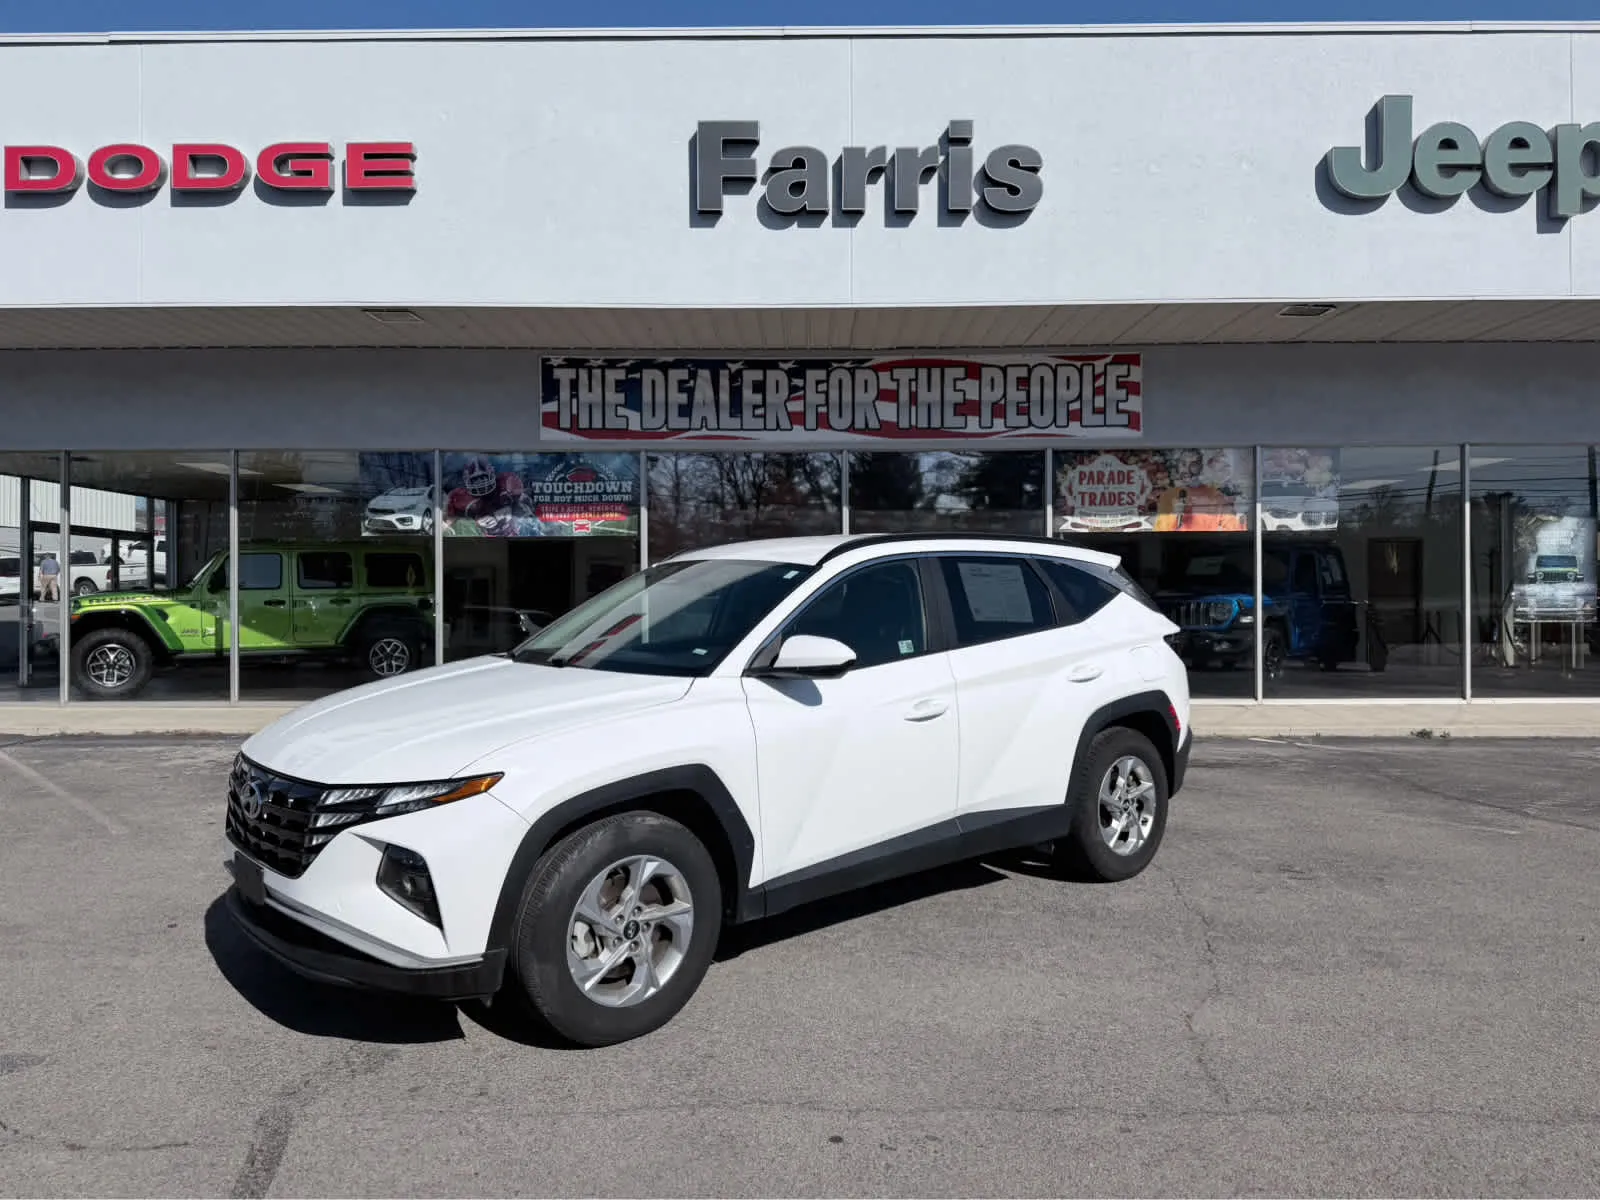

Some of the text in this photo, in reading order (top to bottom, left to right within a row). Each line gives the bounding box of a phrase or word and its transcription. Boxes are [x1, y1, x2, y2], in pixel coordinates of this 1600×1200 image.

[4, 142, 417, 193] DODGE
[696, 119, 1044, 214] Farris
[1330, 94, 1600, 218] Jeep
[552, 363, 1130, 431] THE DEALER FOR THE PEOPLE
[532, 481, 632, 493] TOUCHDOWN
[1079, 470, 1136, 485] PARADE
[574, 494, 600, 502] MUCH
[1078, 492, 1136, 506] TRADES
